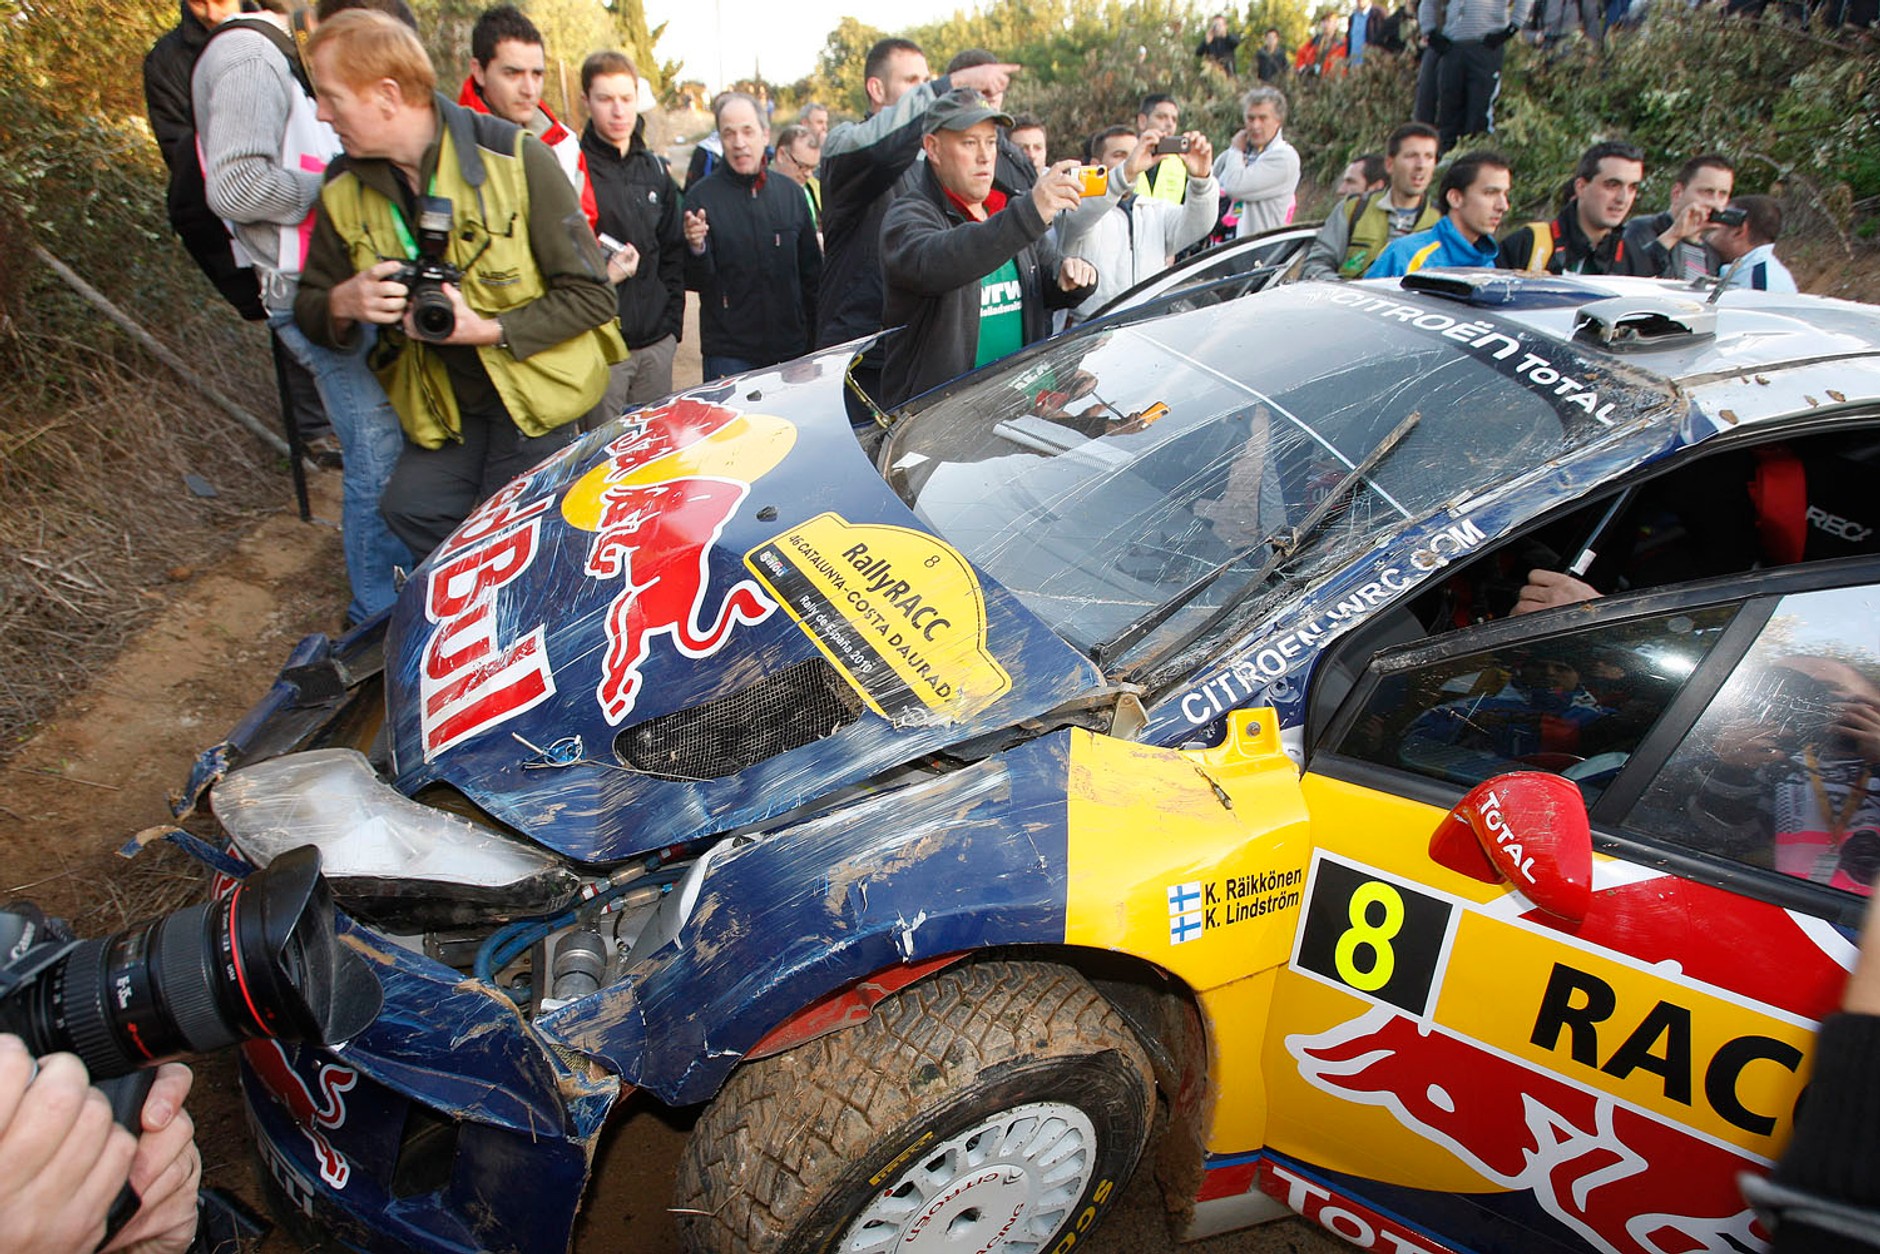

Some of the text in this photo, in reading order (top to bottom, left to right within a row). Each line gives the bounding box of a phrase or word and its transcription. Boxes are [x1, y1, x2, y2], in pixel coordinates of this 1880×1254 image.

[1330, 291, 1617, 426] CITROËN TOTAL
[842, 542, 951, 642] RallyRACC
[923, 554, 941, 569] 8
[422, 516, 556, 763] Bull
[799, 595, 873, 673] Rally de España 2010
[887, 633, 953, 702] DAURAD
[1480, 791, 1537, 884] TOTAL
[1205, 868, 1302, 905] K. Räikkönen
[1205, 891, 1299, 930] K. Lindström
[1335, 881, 1405, 992] 8
